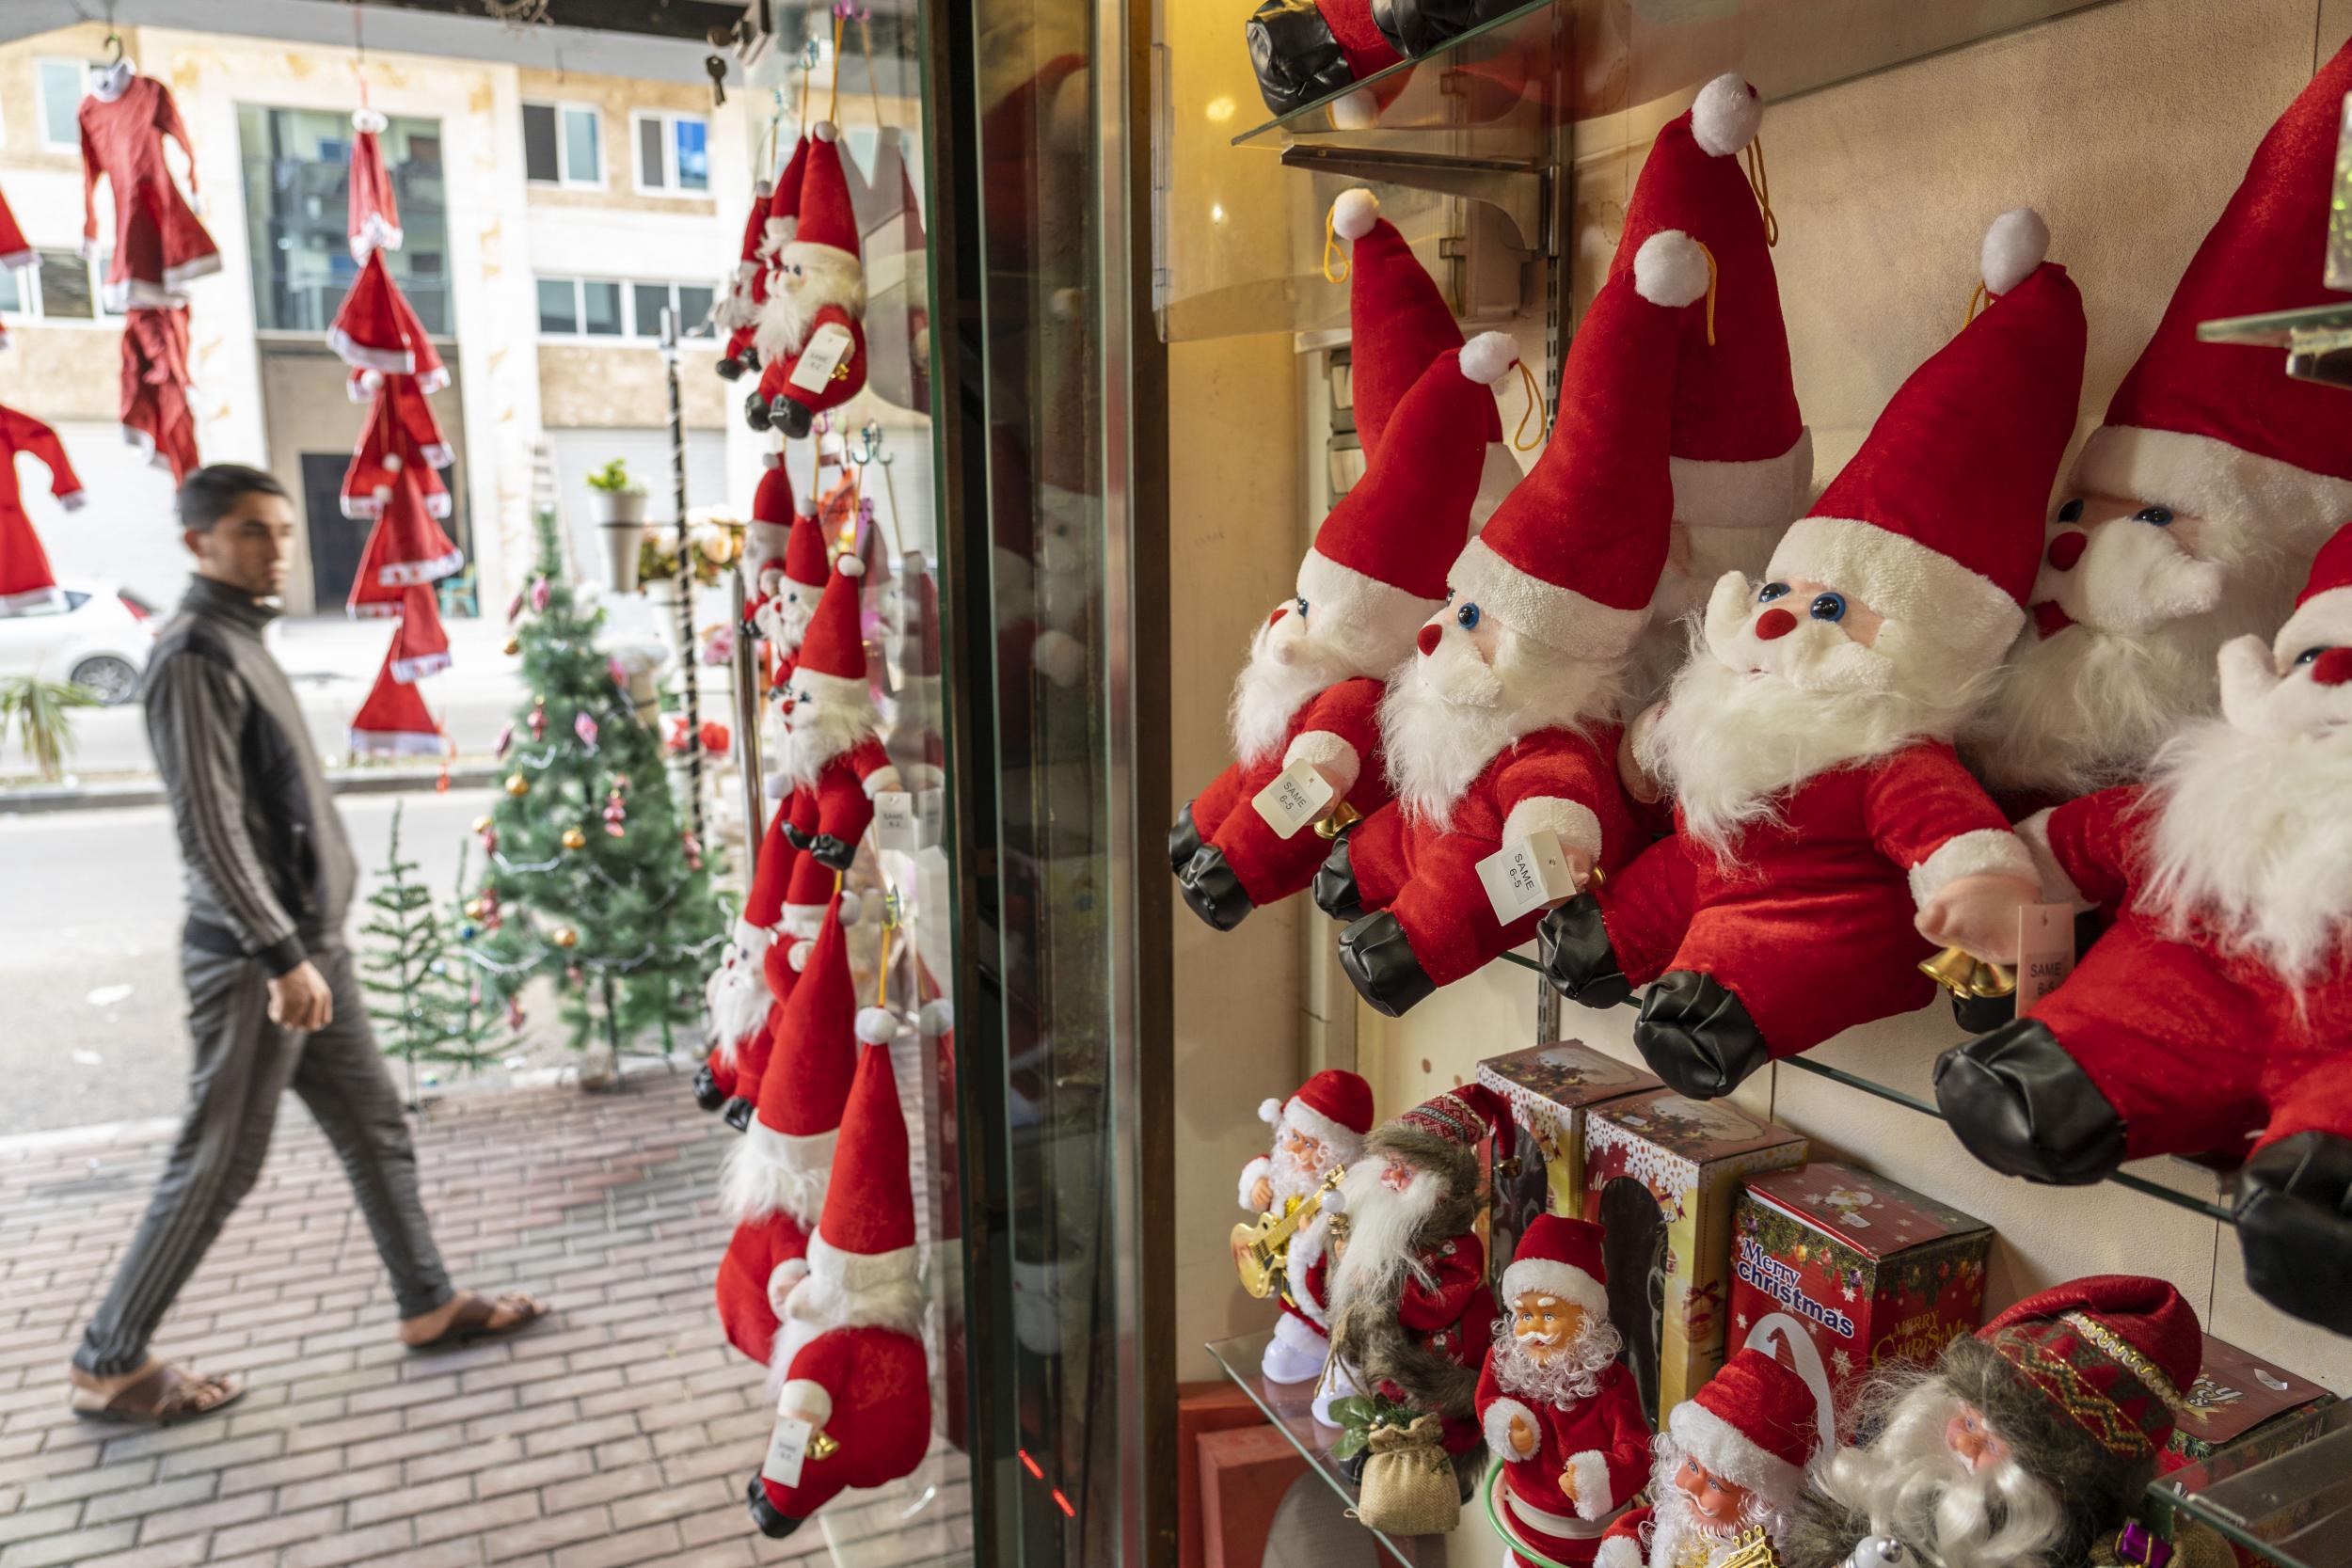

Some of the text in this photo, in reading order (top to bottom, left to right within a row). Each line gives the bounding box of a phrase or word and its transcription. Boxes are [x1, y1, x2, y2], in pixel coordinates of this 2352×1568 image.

[1279, 795, 1294, 810] 6-5
[1283, 782, 1307, 808] SAME
[1509, 868, 1521, 888] 6-5
[1515, 853, 1534, 891] SAME
[2030, 961, 2062, 978] SAME
[1740, 1237, 1801, 1288] Merry
[1738, 1261, 1854, 1338] christmas
[1894, 1309, 1940, 1338] MERRY
[1871, 1318, 1973, 1369] CHRISTM
